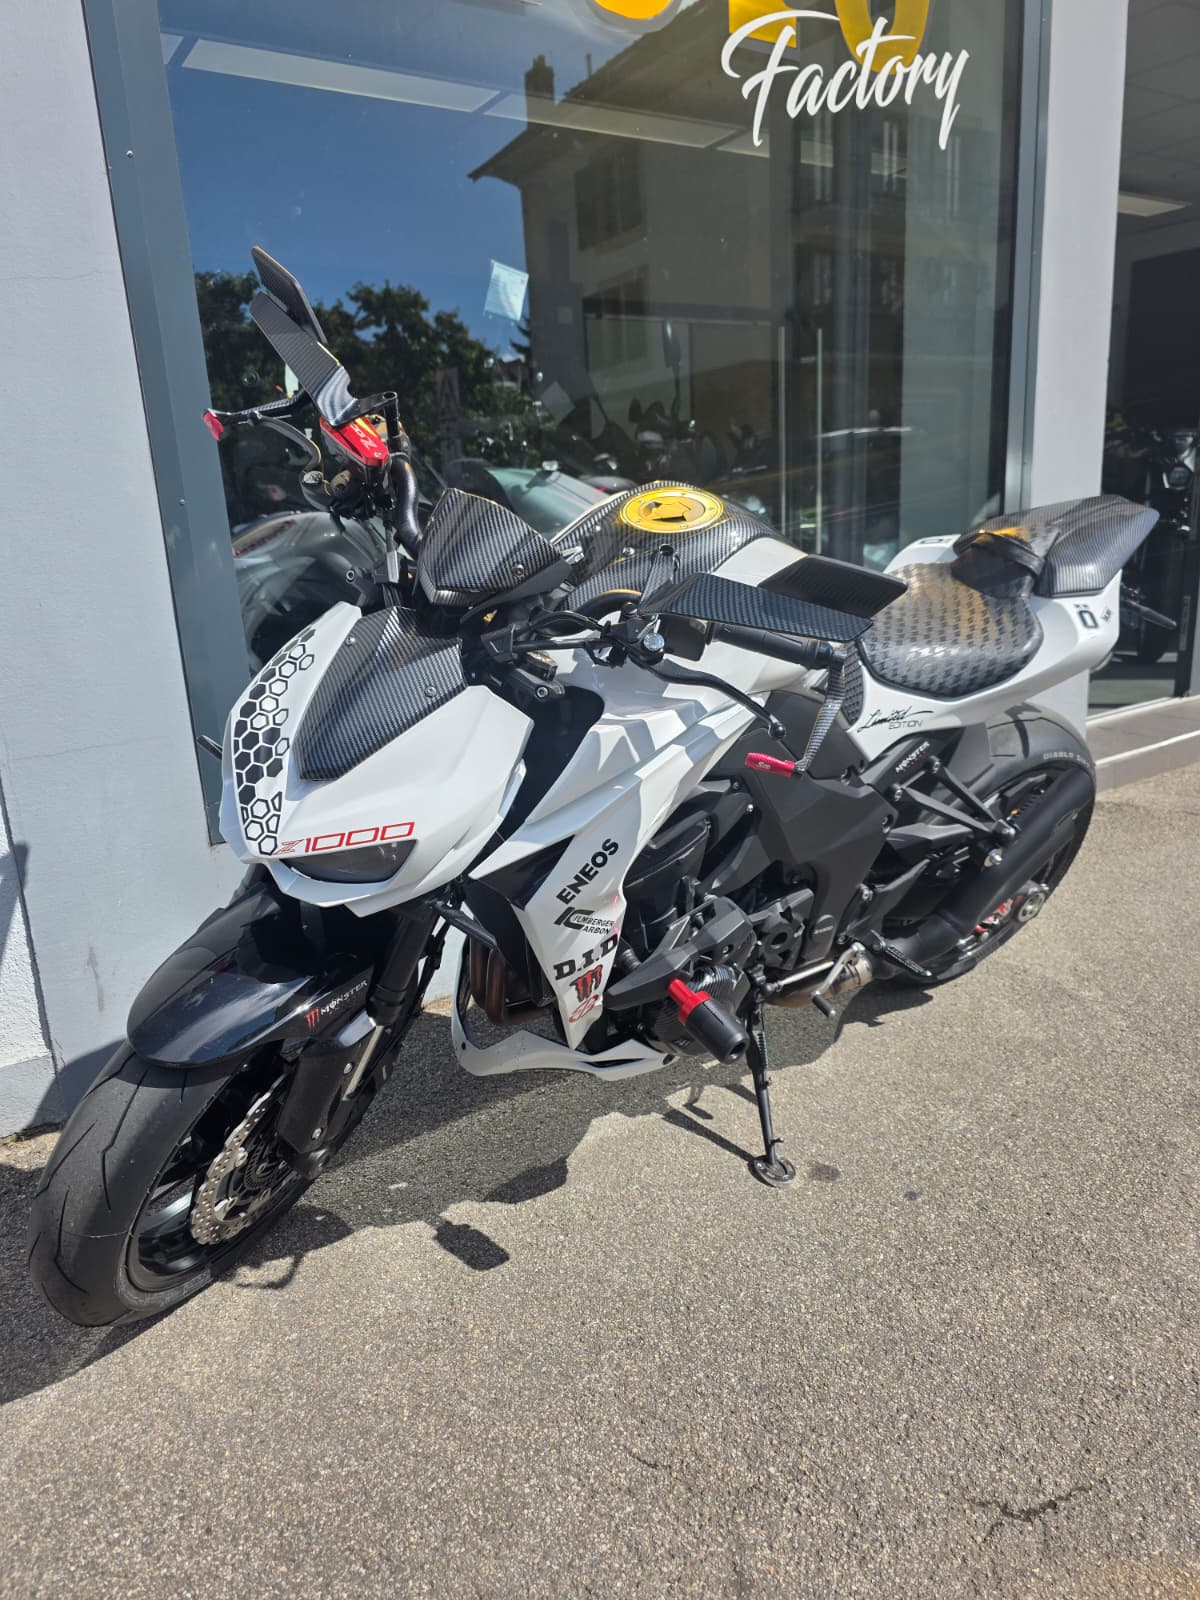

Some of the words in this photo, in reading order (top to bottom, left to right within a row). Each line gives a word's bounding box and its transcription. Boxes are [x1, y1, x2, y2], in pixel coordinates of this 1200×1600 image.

[721, 10, 970, 150] Factory
[857, 706, 934, 732] Limited
[272, 821, 415, 855] Z1000
[556, 838, 620, 905] ENEOS
[553, 934, 618, 980] D.I.D
[320, 979, 368, 1015] MONSTER
